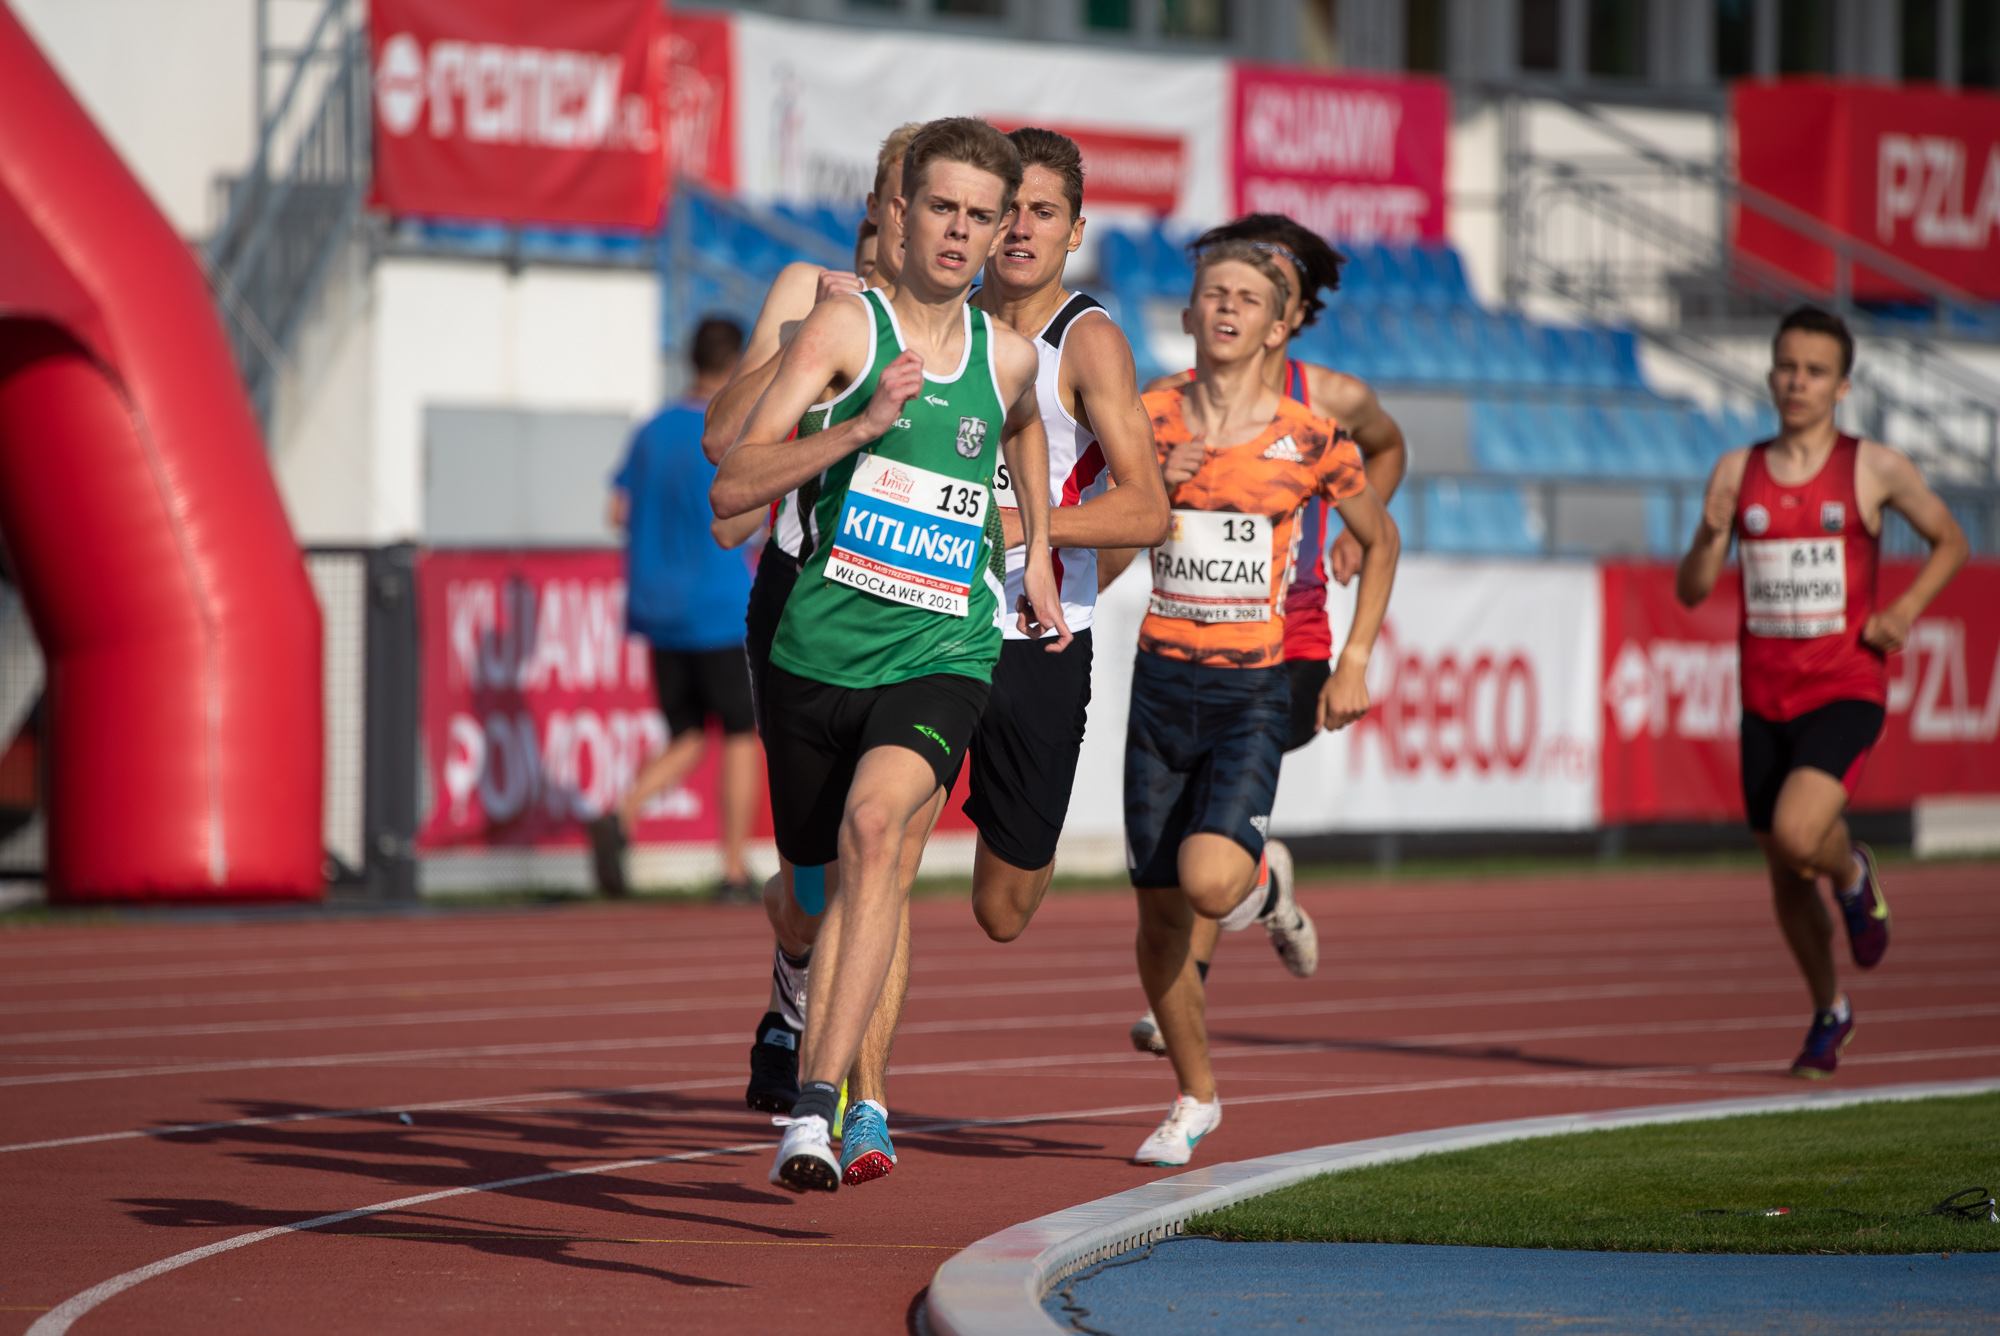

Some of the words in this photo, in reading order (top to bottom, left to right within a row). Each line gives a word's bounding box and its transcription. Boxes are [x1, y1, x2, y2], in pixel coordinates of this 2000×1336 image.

[1264, 449, 1303, 462] adidas
[874, 468, 915, 494] Anwil
[936, 484, 982, 518] 135
[843, 506, 975, 569] KITLIŃSKI
[1222, 518, 1255, 542] 13
[1156, 551, 1266, 585] FRANCZAK
[1790, 543, 1838, 567] 614
[836, 564, 925, 604] WŁOCŁAWEK
[928, 594, 959, 611] 2021
[851, 557, 873, 569] PZLA
[873, 564, 925, 585] MISTRZOSTWA
[925, 580, 949, 590] POLSKI
